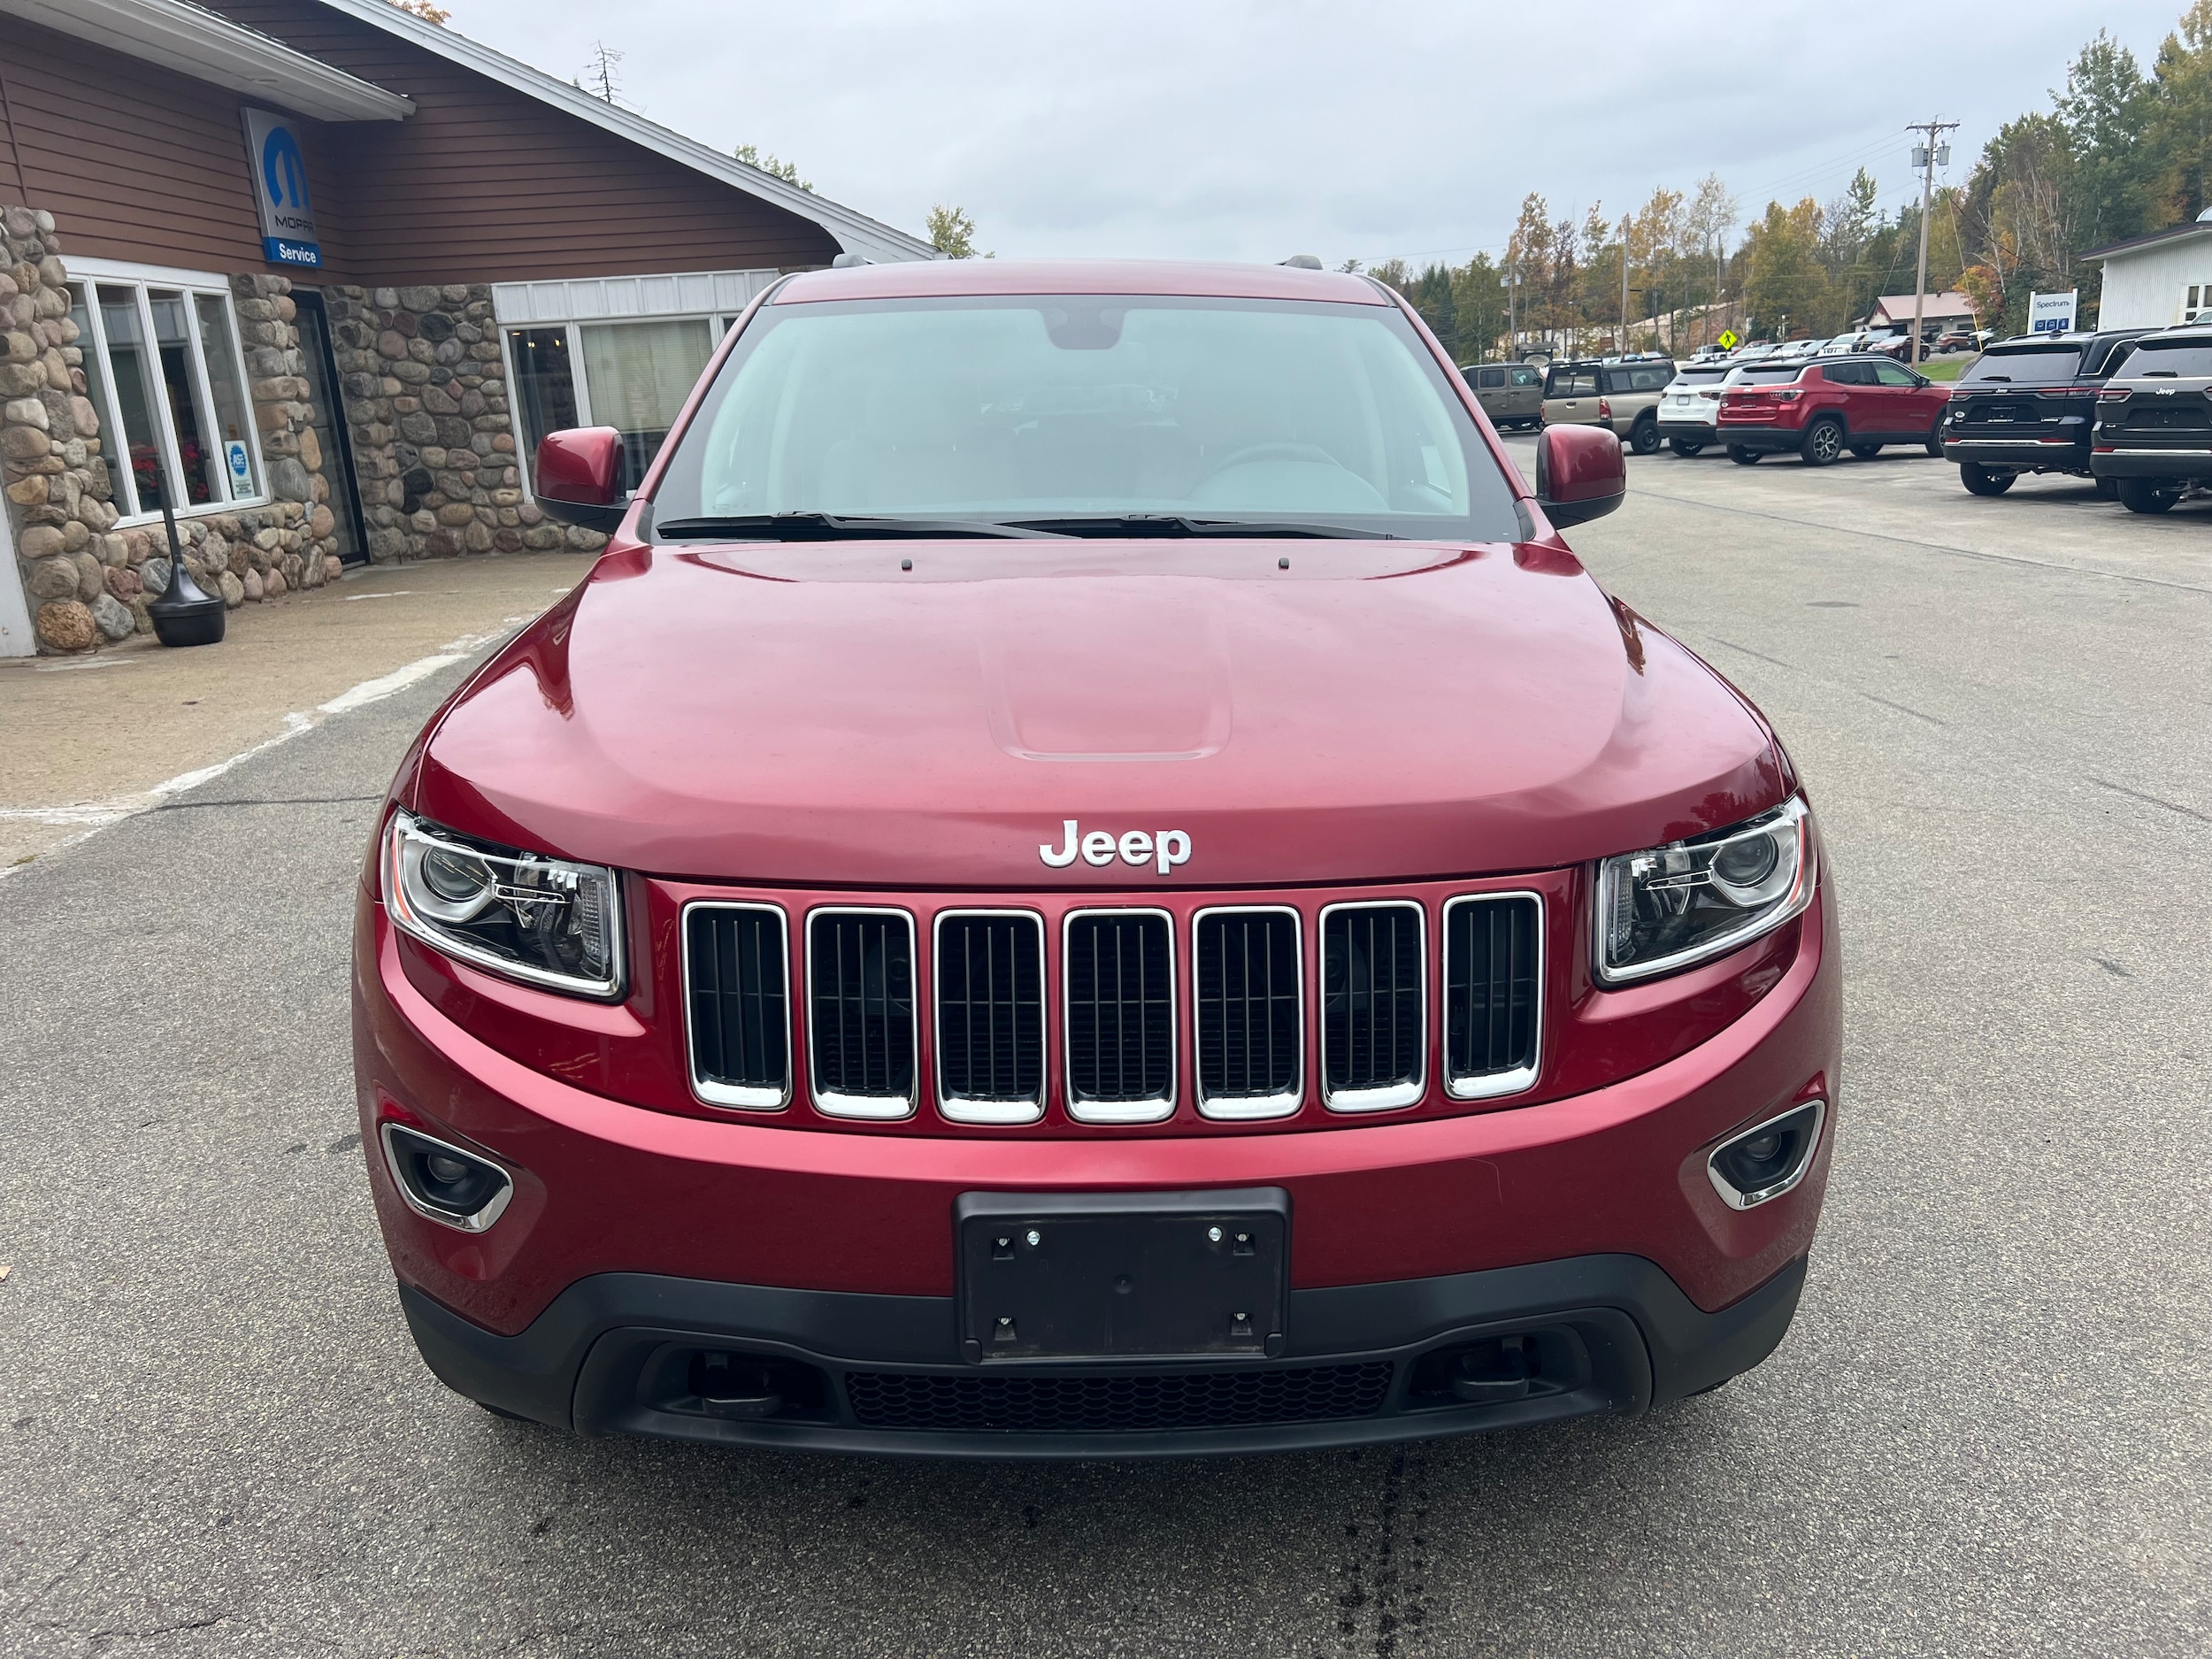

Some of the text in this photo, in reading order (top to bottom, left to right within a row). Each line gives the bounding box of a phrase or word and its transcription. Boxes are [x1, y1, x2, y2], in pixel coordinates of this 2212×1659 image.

[275, 215, 314, 234] MOPAR
[279, 242, 317, 264] Service
[2036, 300, 2070, 310] Spectrum
[2155, 388, 2176, 396] Jeep
[1039, 819, 1192, 876] Jeep
